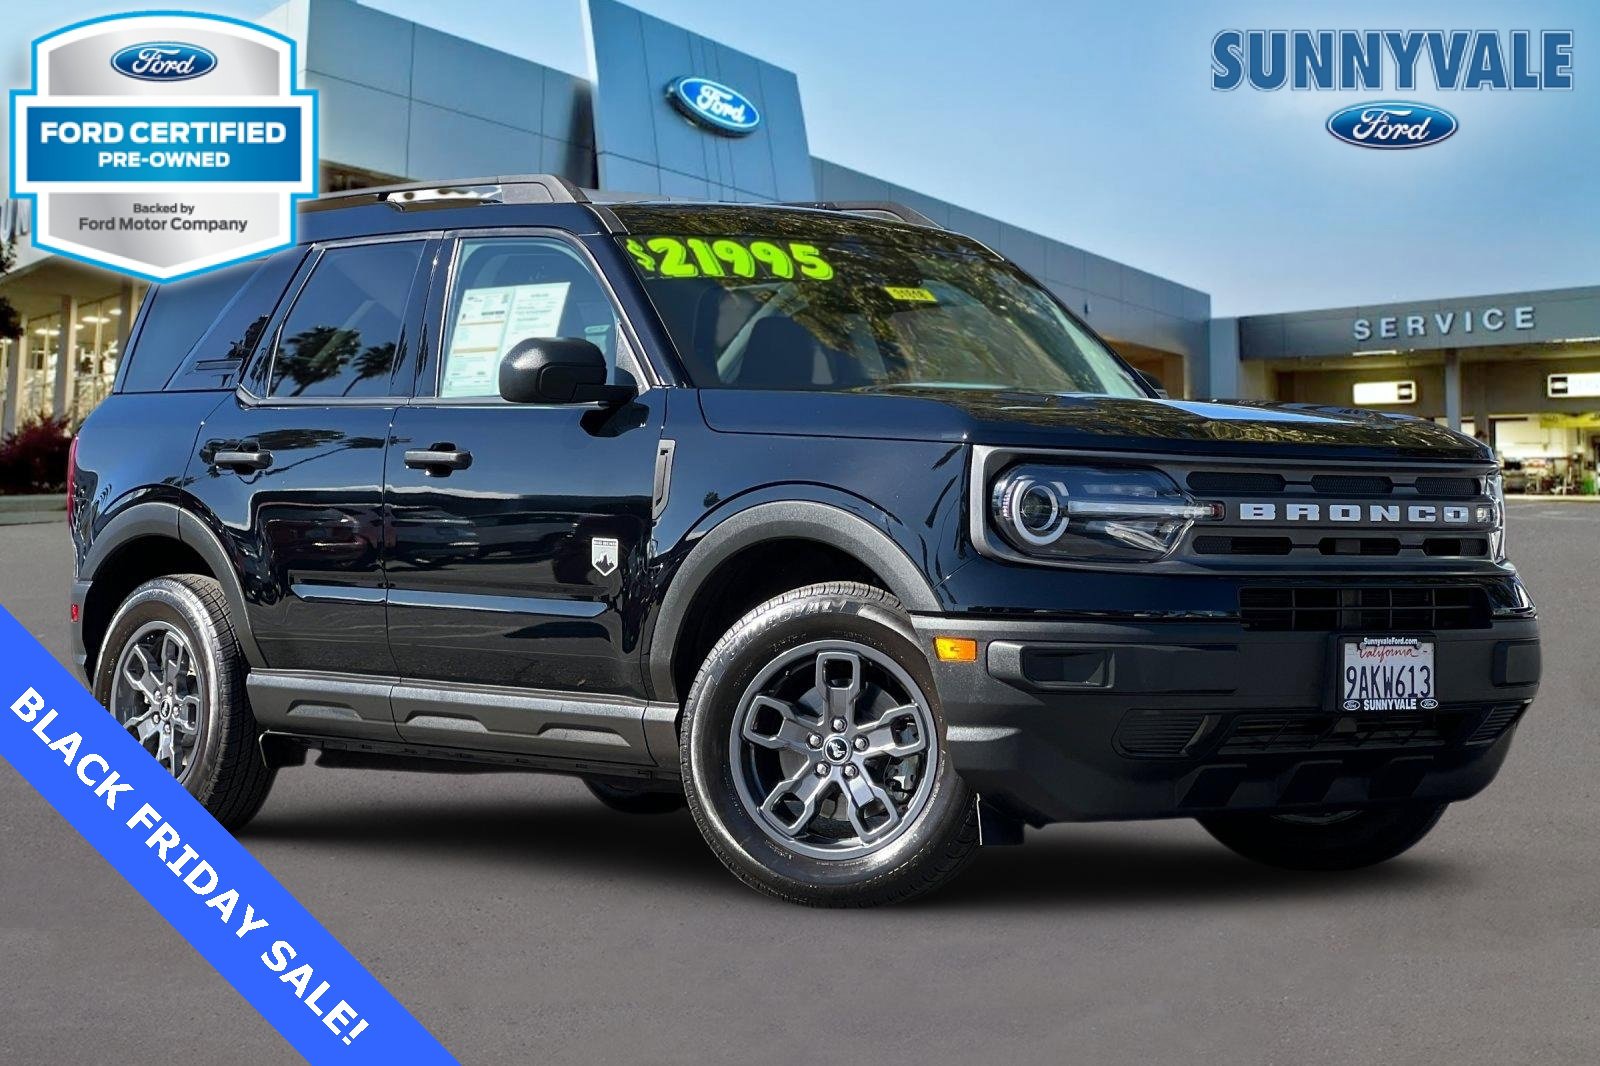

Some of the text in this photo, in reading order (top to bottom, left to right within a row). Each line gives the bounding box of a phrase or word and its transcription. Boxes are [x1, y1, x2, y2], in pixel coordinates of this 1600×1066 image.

[696, 85, 745, 122] Ford
[626, 237, 833, 280] $21995
[1353, 306, 1536, 342] SERVICE
[1239, 503, 1469, 522] BRONCO
[1363, 637, 1418, 646] SunnyvaleFord.com
[1346, 666, 1431, 699] 9AKW613
[1363, 699, 1417, 710] SUNNYVALE
